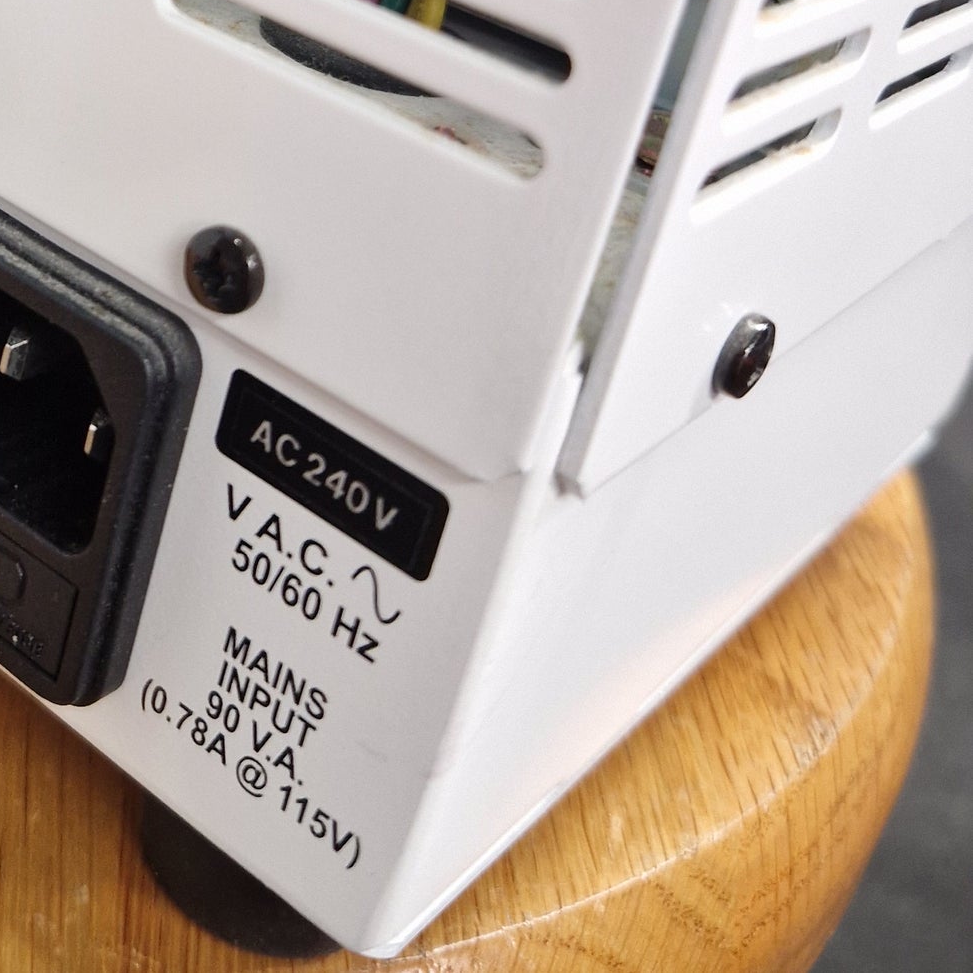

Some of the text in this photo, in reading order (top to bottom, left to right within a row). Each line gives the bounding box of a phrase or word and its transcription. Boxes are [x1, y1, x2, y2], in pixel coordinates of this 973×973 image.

[227, 483, 335, 588] V A.C.
[231, 538, 380, 664] 50/60 Hz
[217, 659, 318, 748] INPUT
[223, 625, 329, 721] MAINS
[141, 678, 361, 870] (0.78A @ 115V)
[205, 689, 304, 787] 90 V.A.
